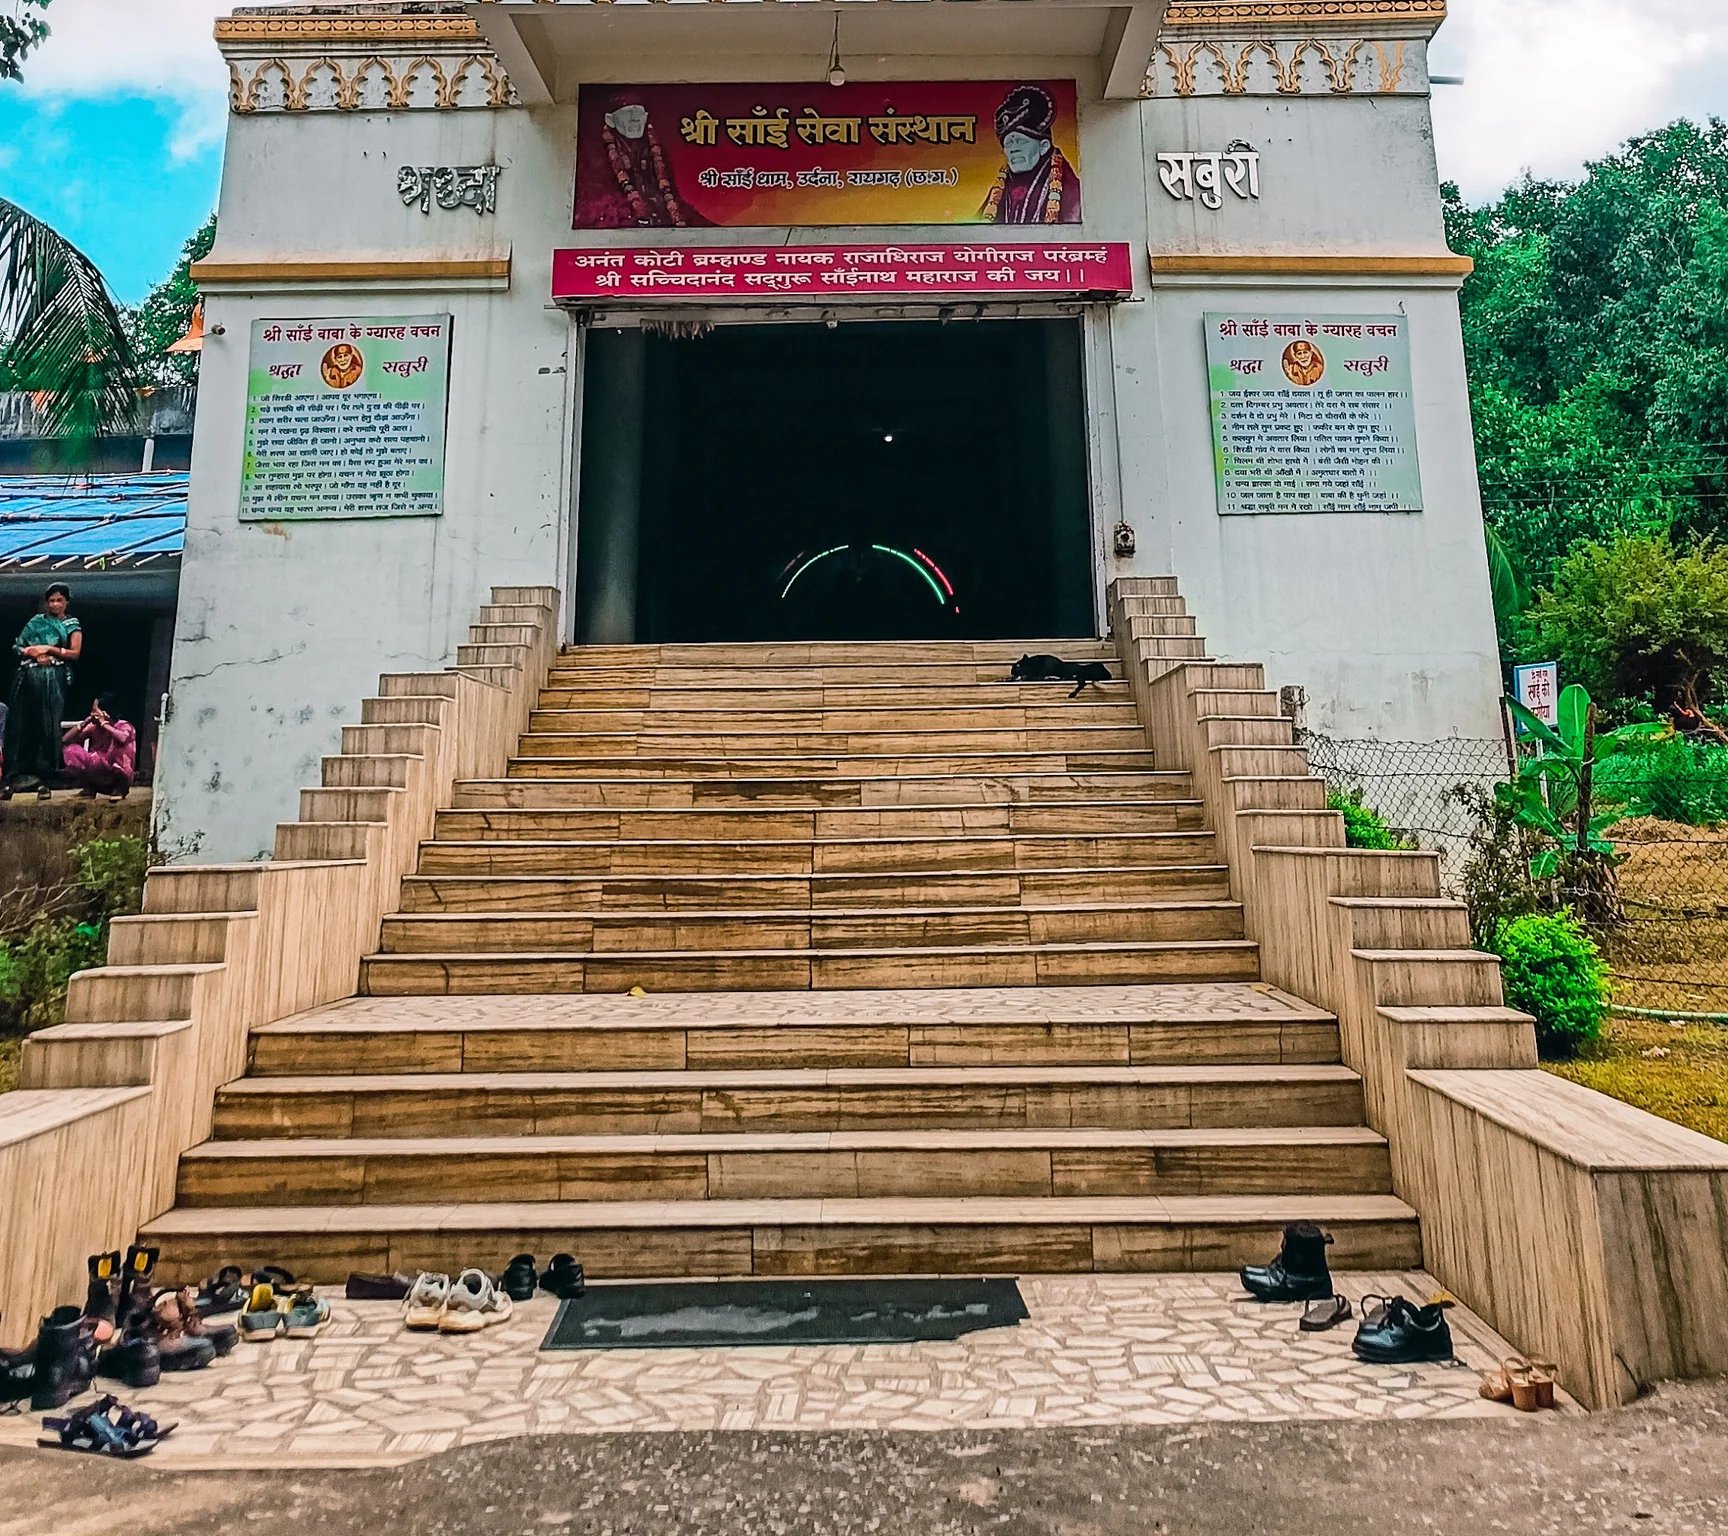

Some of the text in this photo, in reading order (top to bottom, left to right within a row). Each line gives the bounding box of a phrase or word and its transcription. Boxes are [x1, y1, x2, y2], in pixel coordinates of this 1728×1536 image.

[680, 109, 719, 145] श्री
[796, 107, 862, 144] सेवा
[868, 107, 976, 143] संस्थान
[699, 168, 719, 187] श्री
[575, 251, 625, 267] अनंत
[634, 250, 684, 267] कोटी
[693, 253, 767, 267] ब्रम्हाण्ड
[775, 252, 835, 266] नायक
[843, 247, 945, 265] राजाधिराज
[953, 246, 1035, 264] योगीराज
[595, 270, 622, 287] श्री
[630, 269, 735, 287] सच्चिदानंद
[906, 268, 978, 285] महाराज
[986, 266, 1016, 283] की
[262, 325, 283, 342] श्री
[349, 323, 361, 340] के
[366, 326, 405, 341] ग्यारह
[410, 324, 441, 338] वचन
[1219, 319, 1237, 337] श्री
[1305, 319, 1318, 337] के
[1322, 323, 1362, 339] ग्यारह
[1366, 323, 1397, 337] वचन
[382, 356, 428, 377] सबुरी
[1343, 355, 1389, 376] सबुरी
